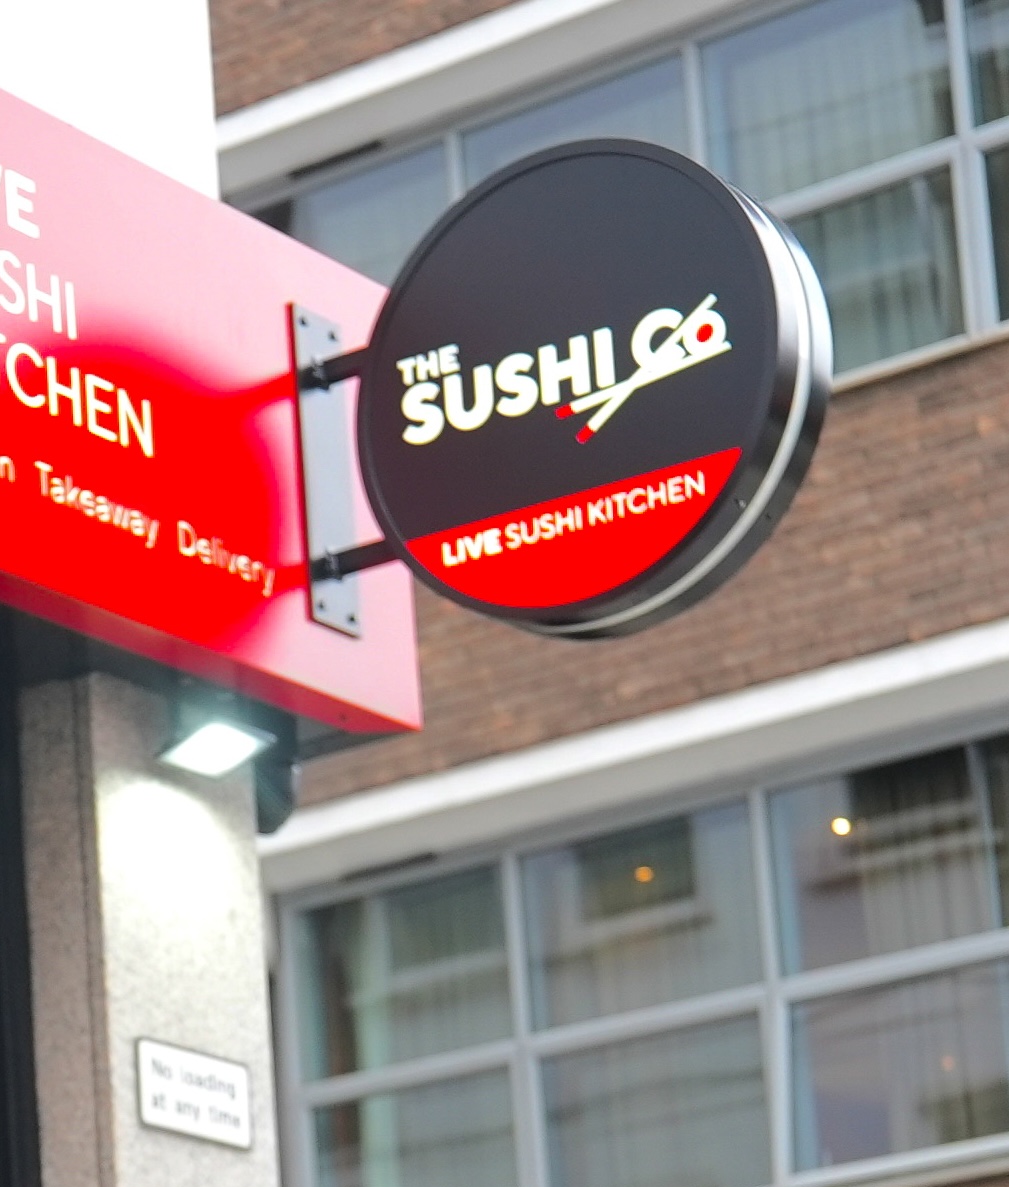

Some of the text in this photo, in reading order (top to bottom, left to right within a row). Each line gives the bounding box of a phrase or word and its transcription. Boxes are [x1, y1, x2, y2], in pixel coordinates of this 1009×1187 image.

[396, 343, 460, 386] THE
[400, 326, 617, 446] SUSHI
[34, 460, 160, 549] Takeaway
[177, 520, 277, 597] Delivery
[441, 470, 706, 567] LIVE SUSHI KITCHEN
[151, 1057, 236, 1100] No loading
[151, 1093, 241, 1128] at any time
